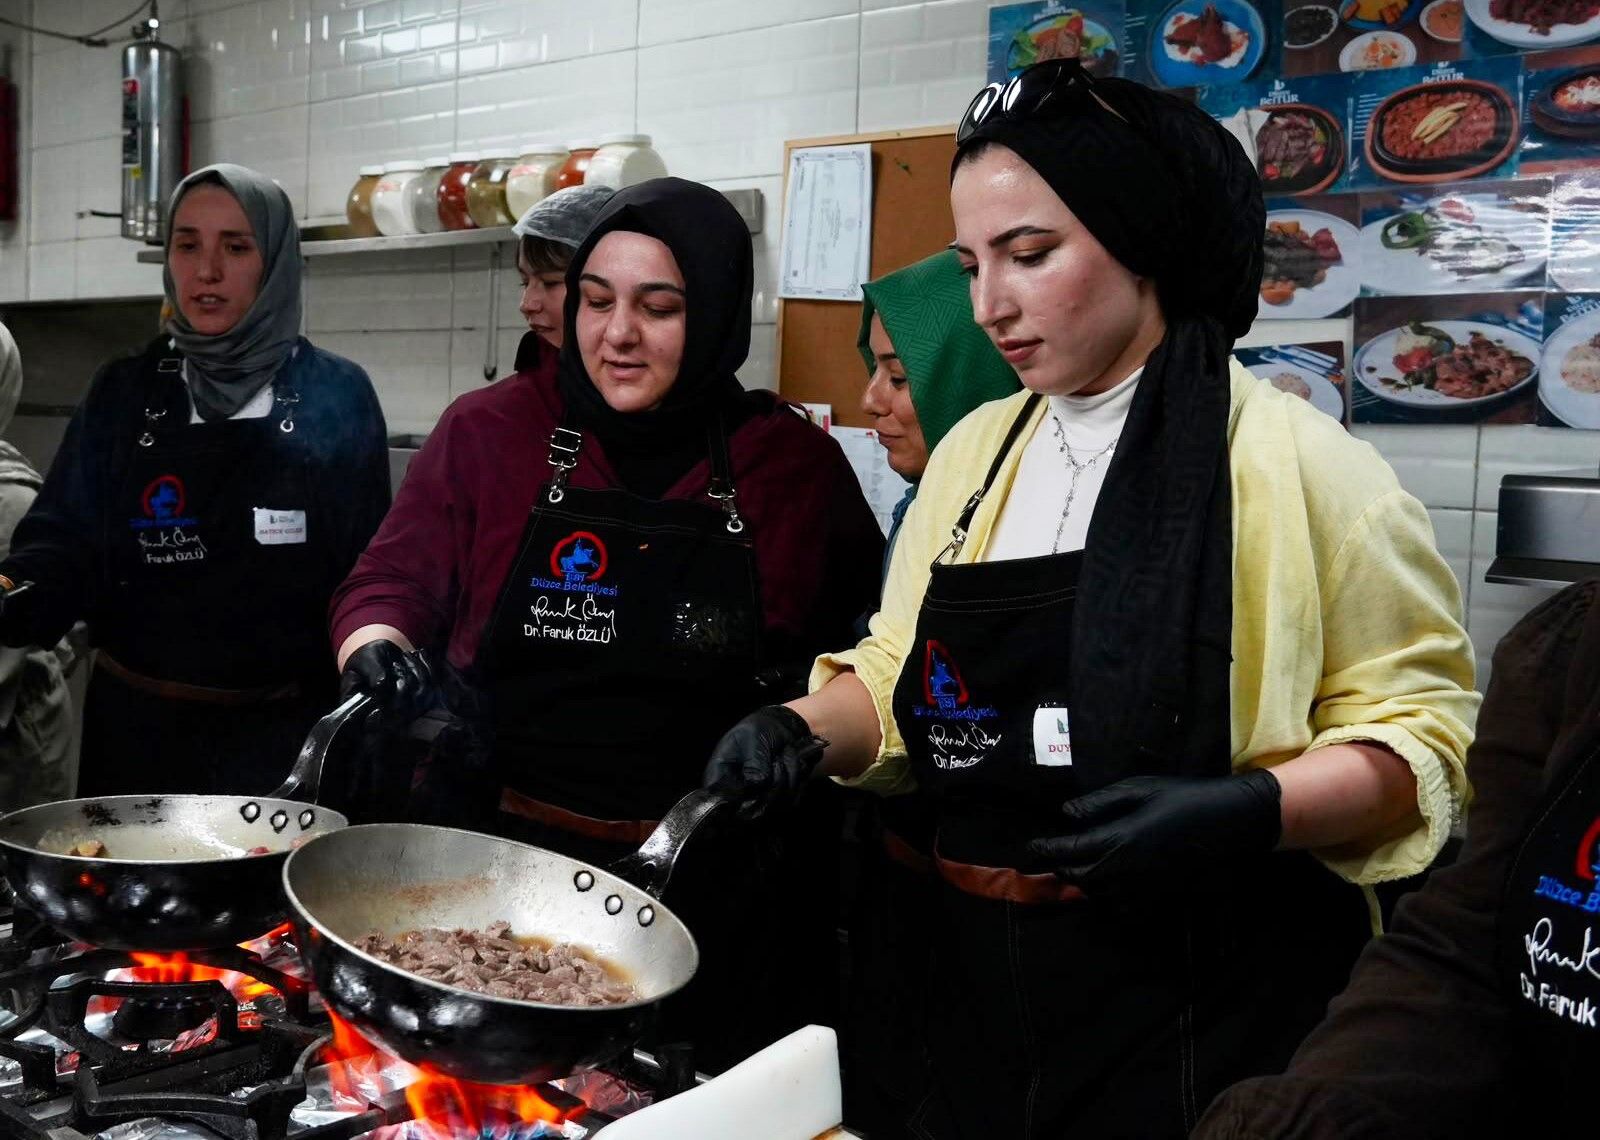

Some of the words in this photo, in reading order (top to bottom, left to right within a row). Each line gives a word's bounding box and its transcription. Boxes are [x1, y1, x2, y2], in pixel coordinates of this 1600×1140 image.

[531, 577, 561, 590] Düzce
[563, 580, 619, 597] Belediyesi
[524, 623, 541, 637] Dr.
[543, 625, 574, 641] Faruk
[576, 623, 611, 643] ÖZLÜ
[1534, 875, 1583, 906] Düzce
[1519, 971, 1537, 1003] Dr.
[1538, 982, 1598, 1029] Faruk
